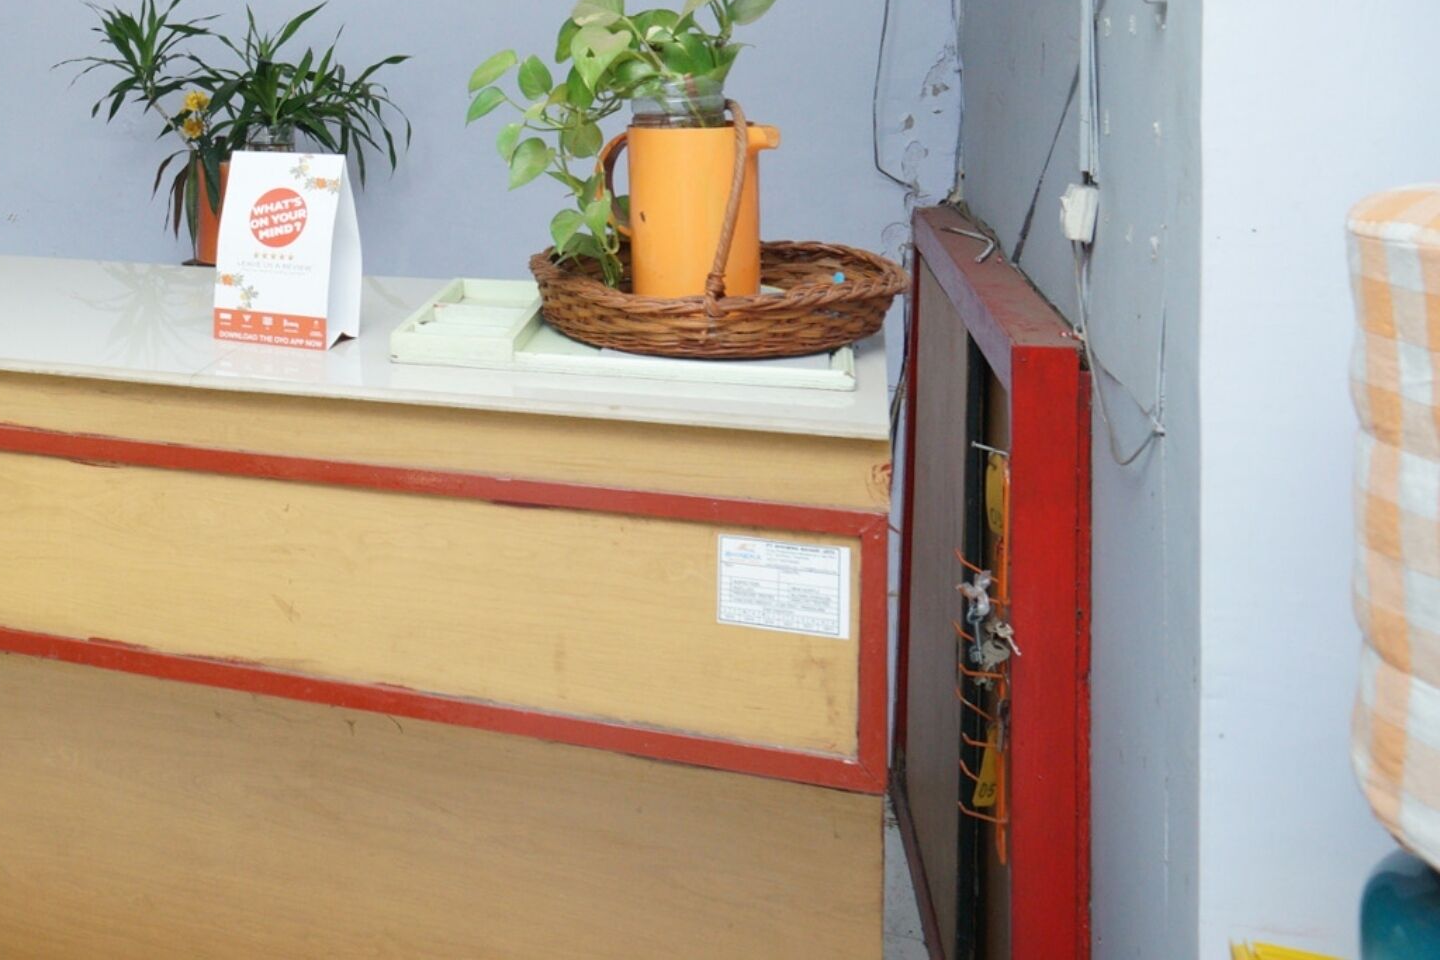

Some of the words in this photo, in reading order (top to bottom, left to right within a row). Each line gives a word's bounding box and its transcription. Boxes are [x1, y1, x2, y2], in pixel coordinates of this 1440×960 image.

[254, 197, 302, 214] WHAT'S
[251, 217, 269, 229] ON
[271, 209, 306, 224] YOUR
[219, 330, 258, 341] DOWNLOAD
[259, 334, 273, 343] THE
[290, 337, 304, 346] APP
[305, 339, 323, 348] NOW
